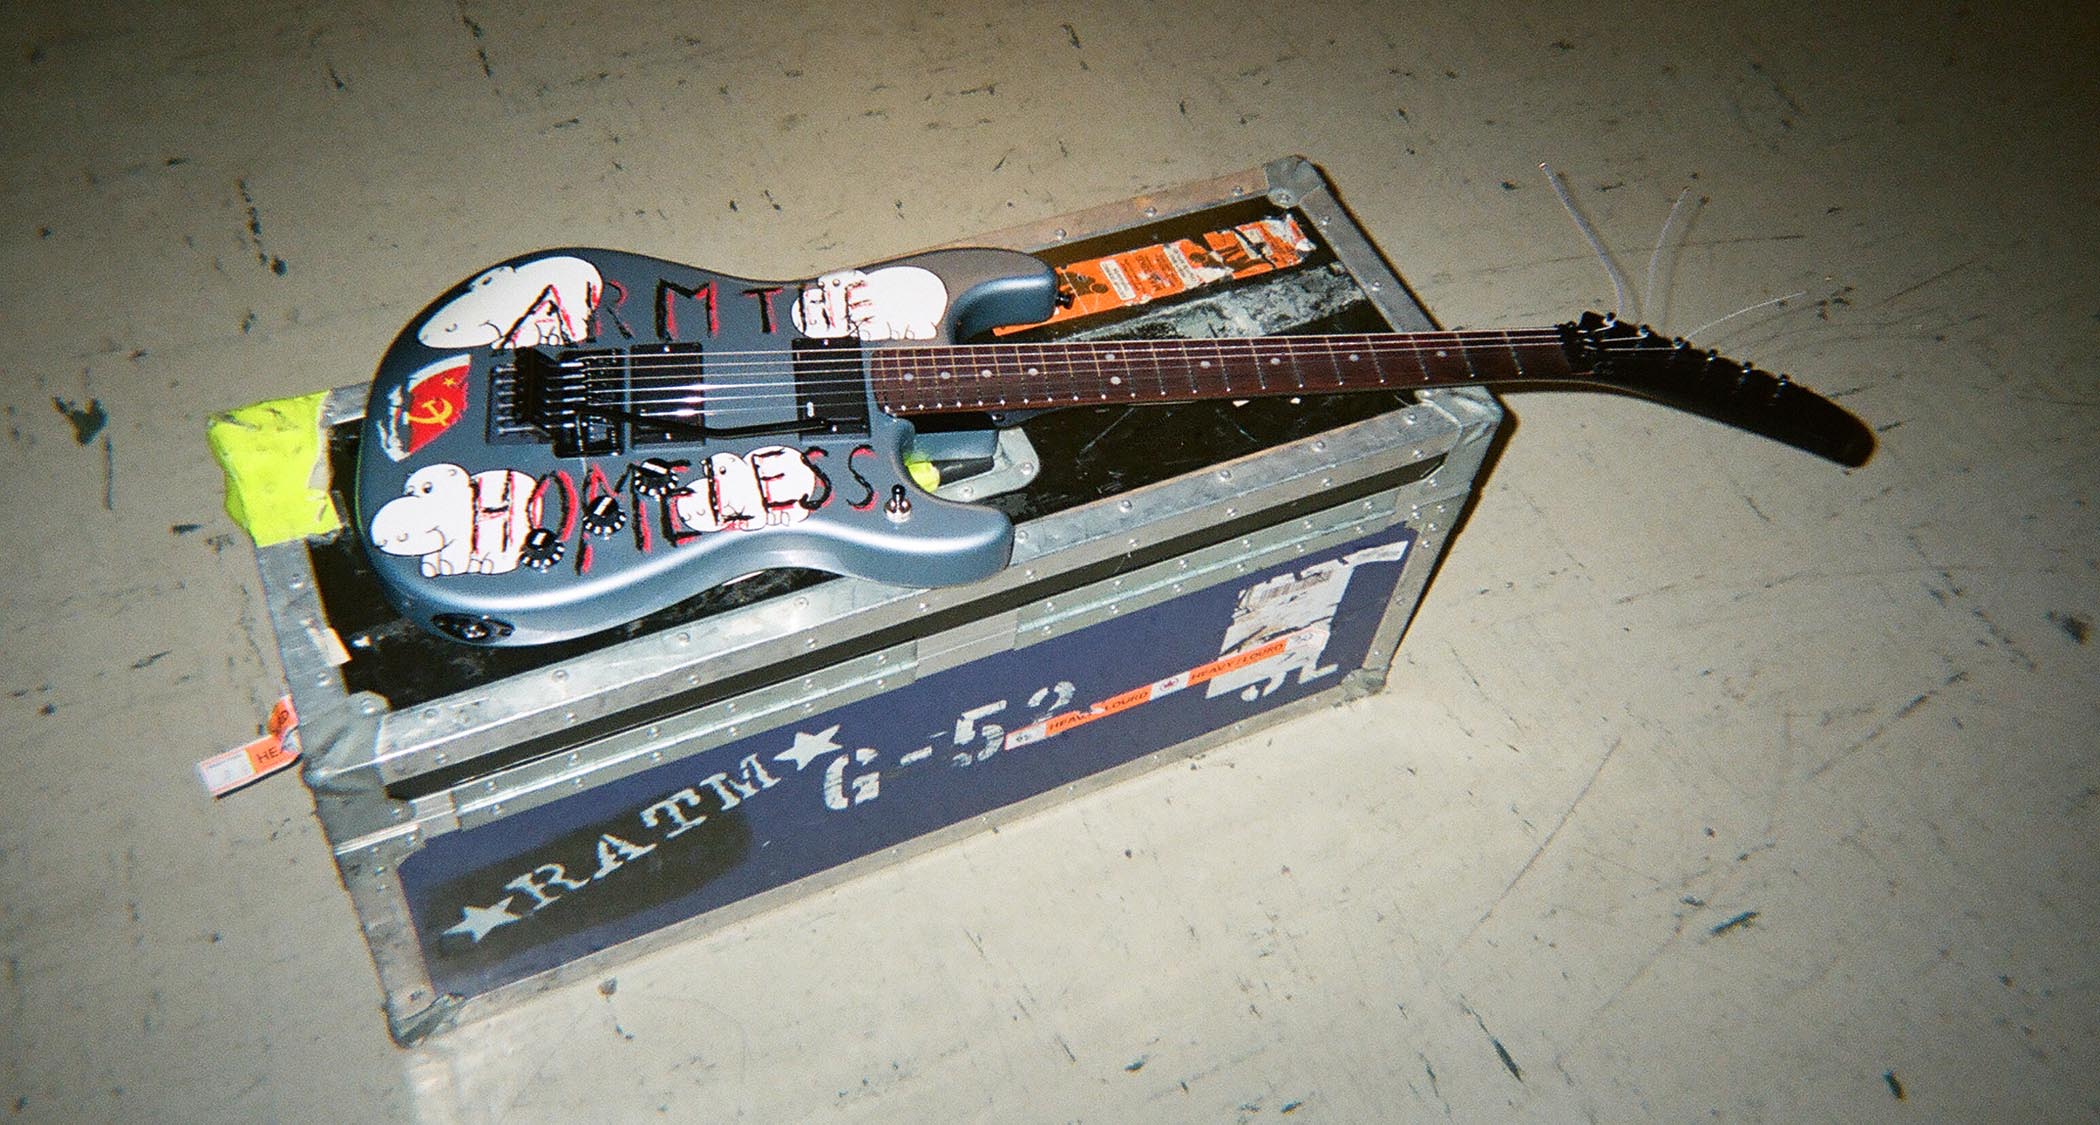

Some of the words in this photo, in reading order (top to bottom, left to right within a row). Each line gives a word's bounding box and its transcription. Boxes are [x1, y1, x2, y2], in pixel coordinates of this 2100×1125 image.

[490, 277, 727, 349] ARM
[741, 280, 875, 337] THE
[468, 444, 880, 575] HOMELESS
[823, 681, 1076, 810] G-52
[504, 753, 781, 914] RATM
